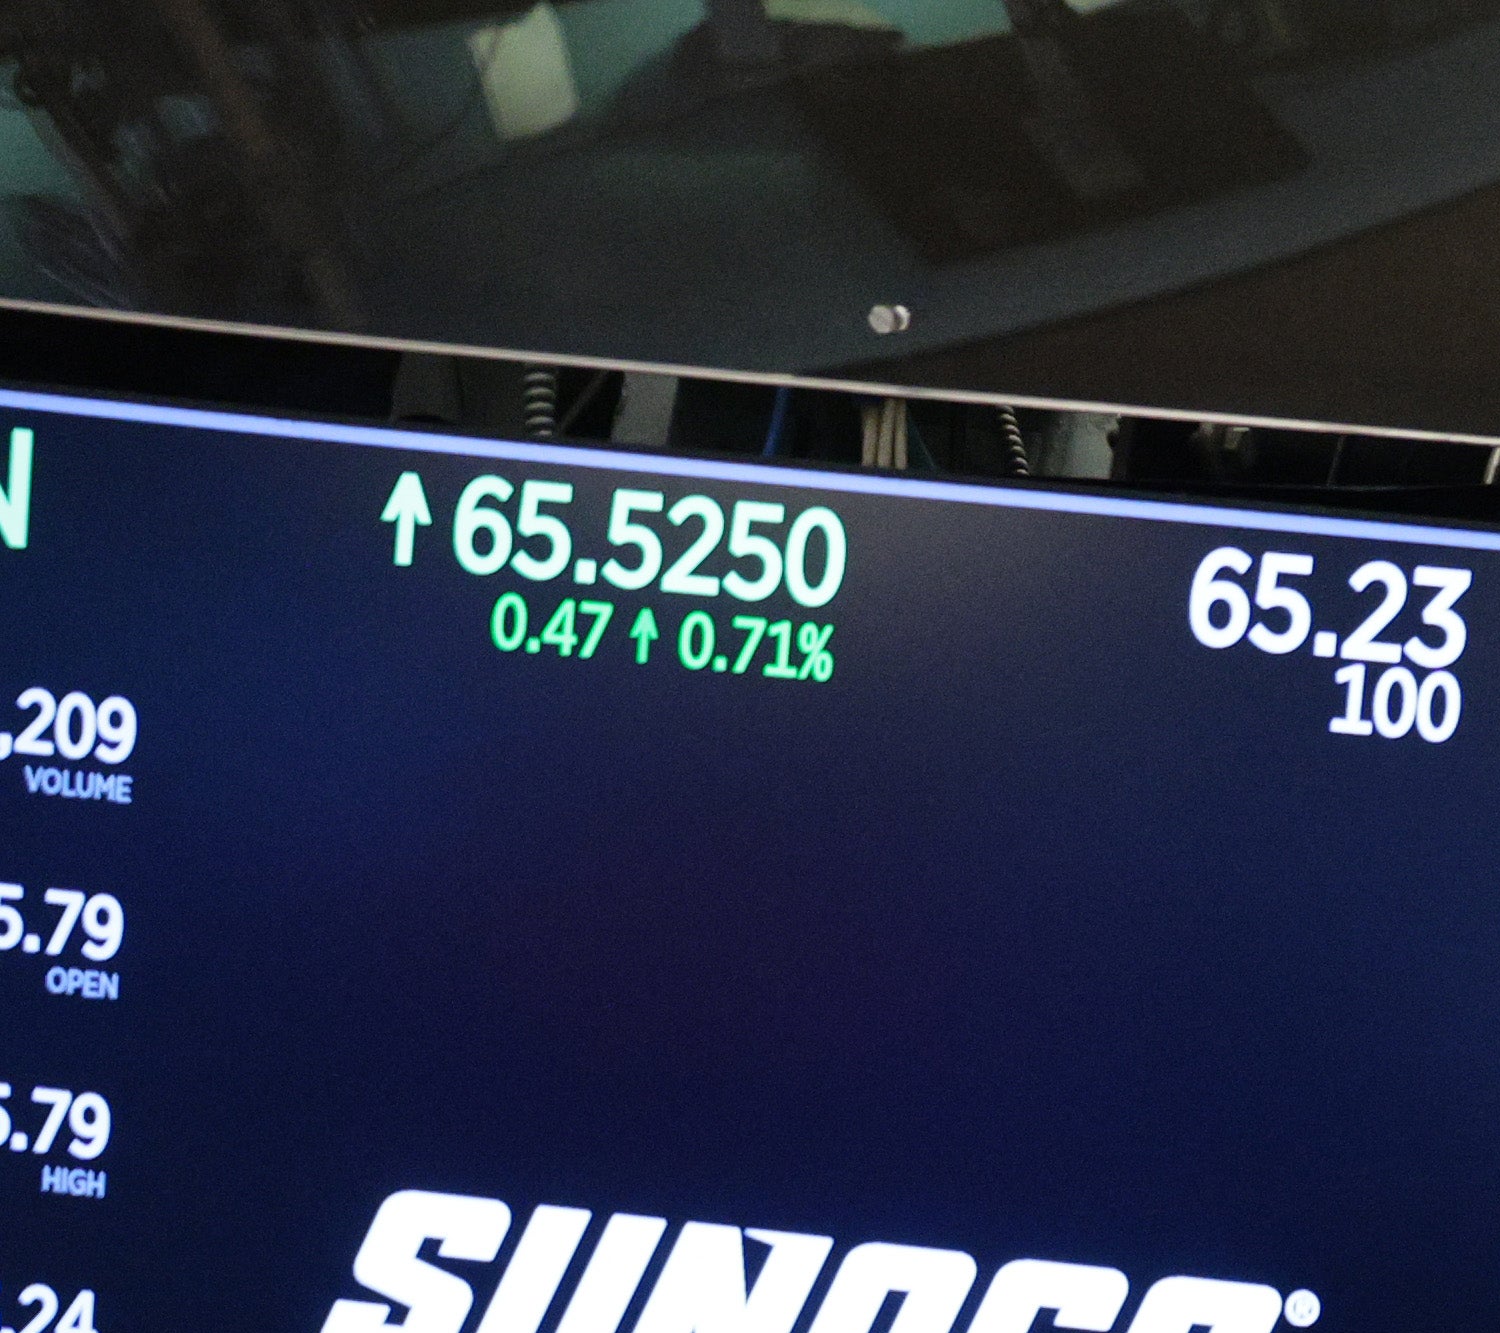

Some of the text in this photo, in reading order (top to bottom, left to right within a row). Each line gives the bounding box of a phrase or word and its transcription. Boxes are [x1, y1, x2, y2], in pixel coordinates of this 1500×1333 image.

[452, 474, 846, 607] 65.5250
[491, 592, 834, 682] 0.47 0.71%
[1187, 546, 1472, 668] 65.23
[1330, 664, 1462, 743] 100
[23, 765, 133, 804] VOLUME
[45, 966, 120, 1000] OPEN
[41, 1164, 107, 1199] HIGH
